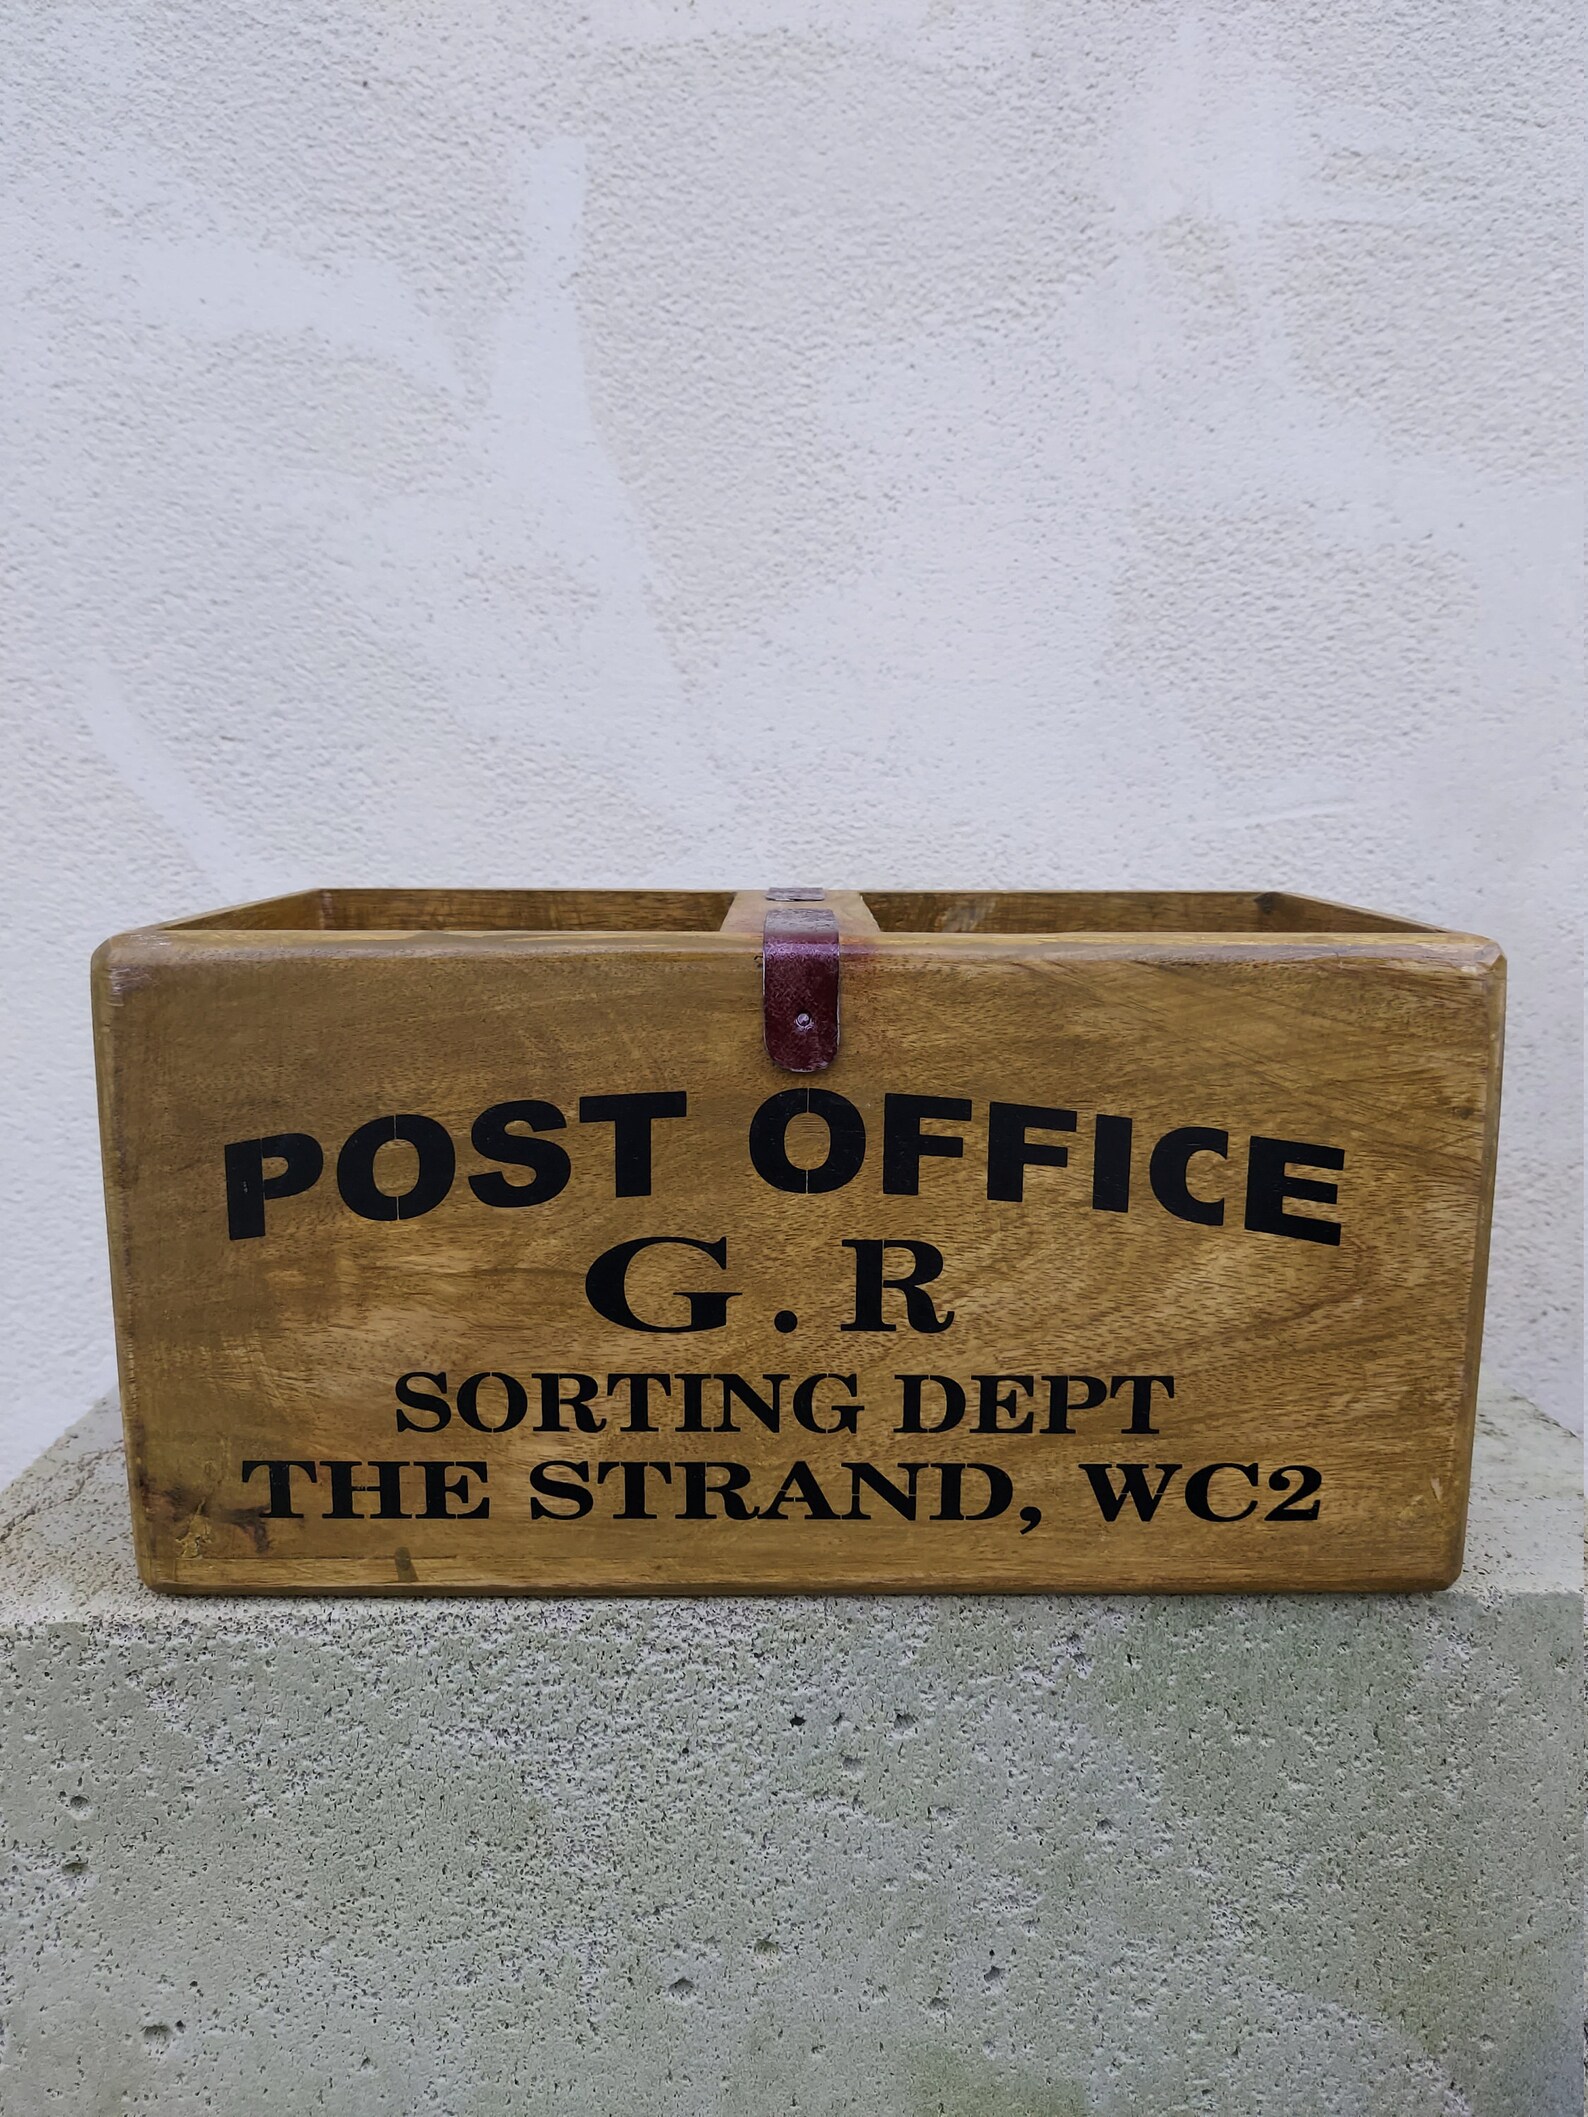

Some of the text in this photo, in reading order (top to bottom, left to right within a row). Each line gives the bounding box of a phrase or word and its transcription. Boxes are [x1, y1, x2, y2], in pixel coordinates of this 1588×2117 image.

[224, 1087, 1346, 1247] POST OFFICE
[395, 1371, 1176, 1436] SORTING DEPT
[242, 1460, 1323, 1535] THE STRAND, WC2
